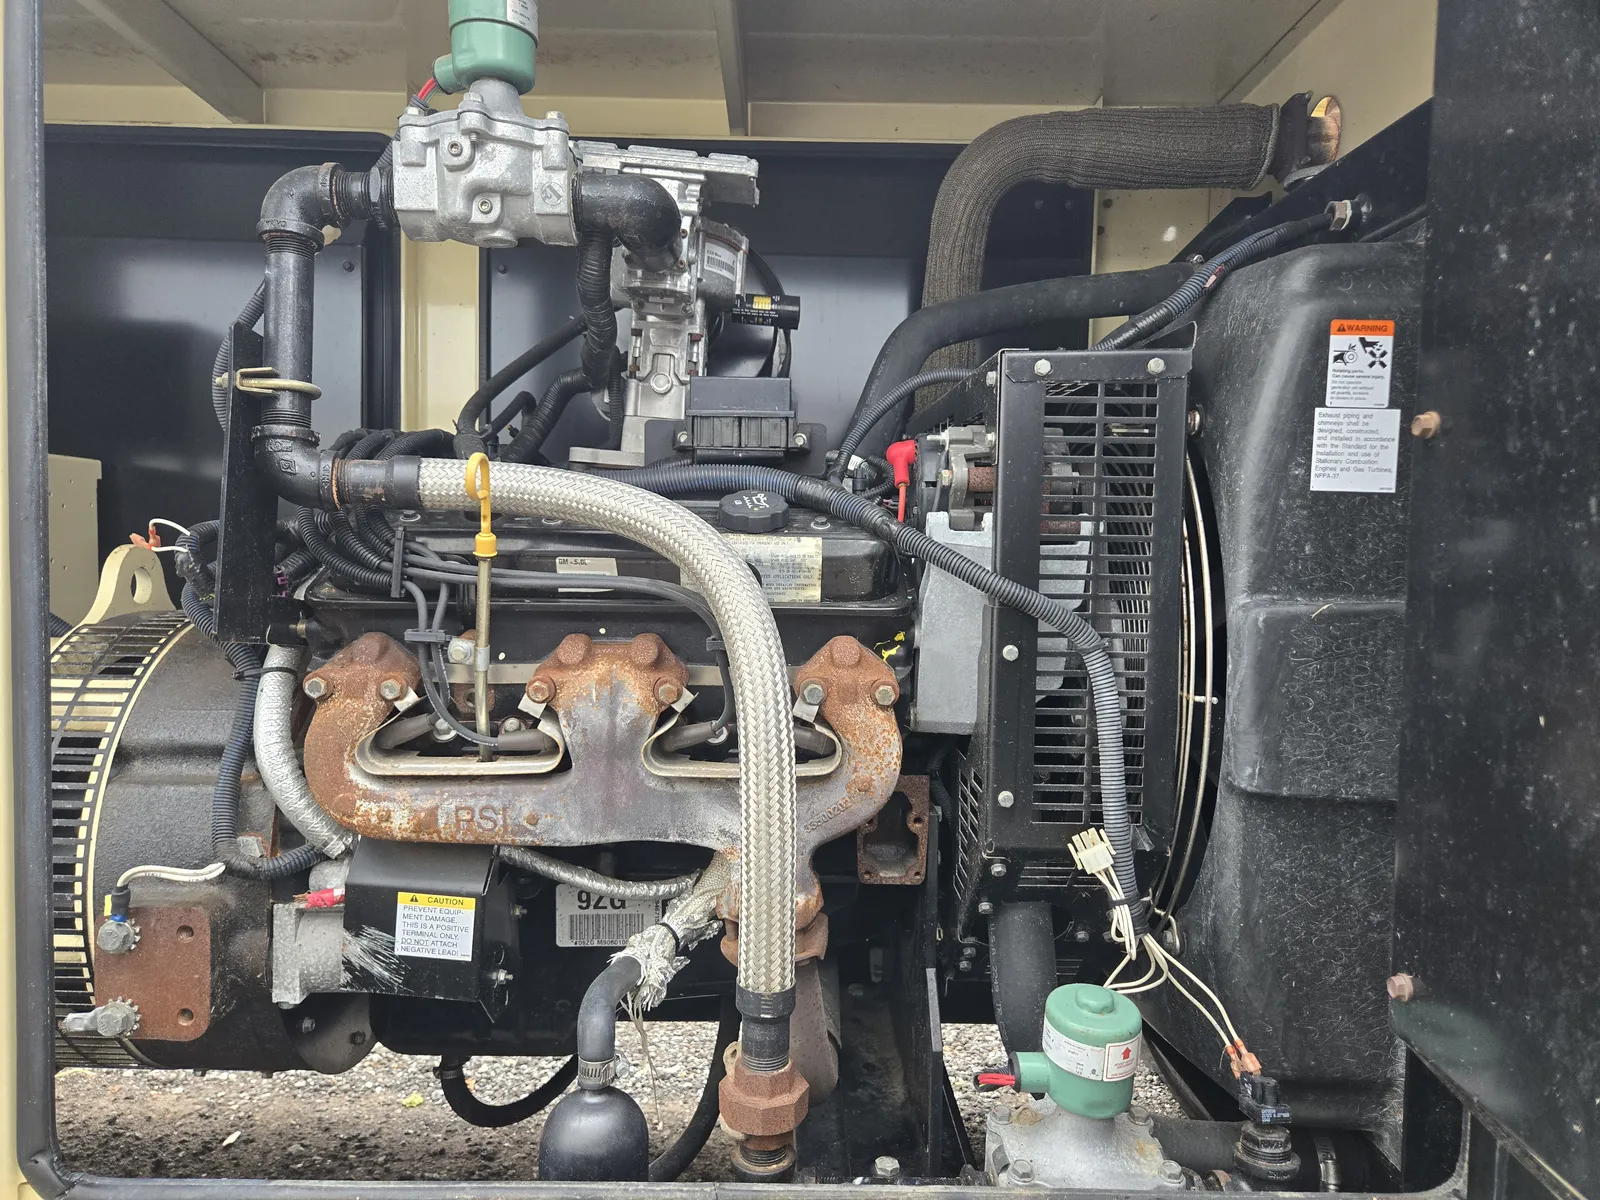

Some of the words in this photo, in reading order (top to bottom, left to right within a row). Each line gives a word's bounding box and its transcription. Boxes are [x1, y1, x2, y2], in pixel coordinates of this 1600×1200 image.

[1346, 324, 1388, 332] WARNING
[455, 804, 510, 832] PSI
[428, 896, 464, 905] CAUTION
[403, 905, 437, 913] PREVENT
[425, 915, 457, 923] DAMAGE.
[436, 924, 469, 932] POSITIVE
[402, 929, 438, 938] TERMINAL
[400, 946, 436, 954] NEGATIVE
